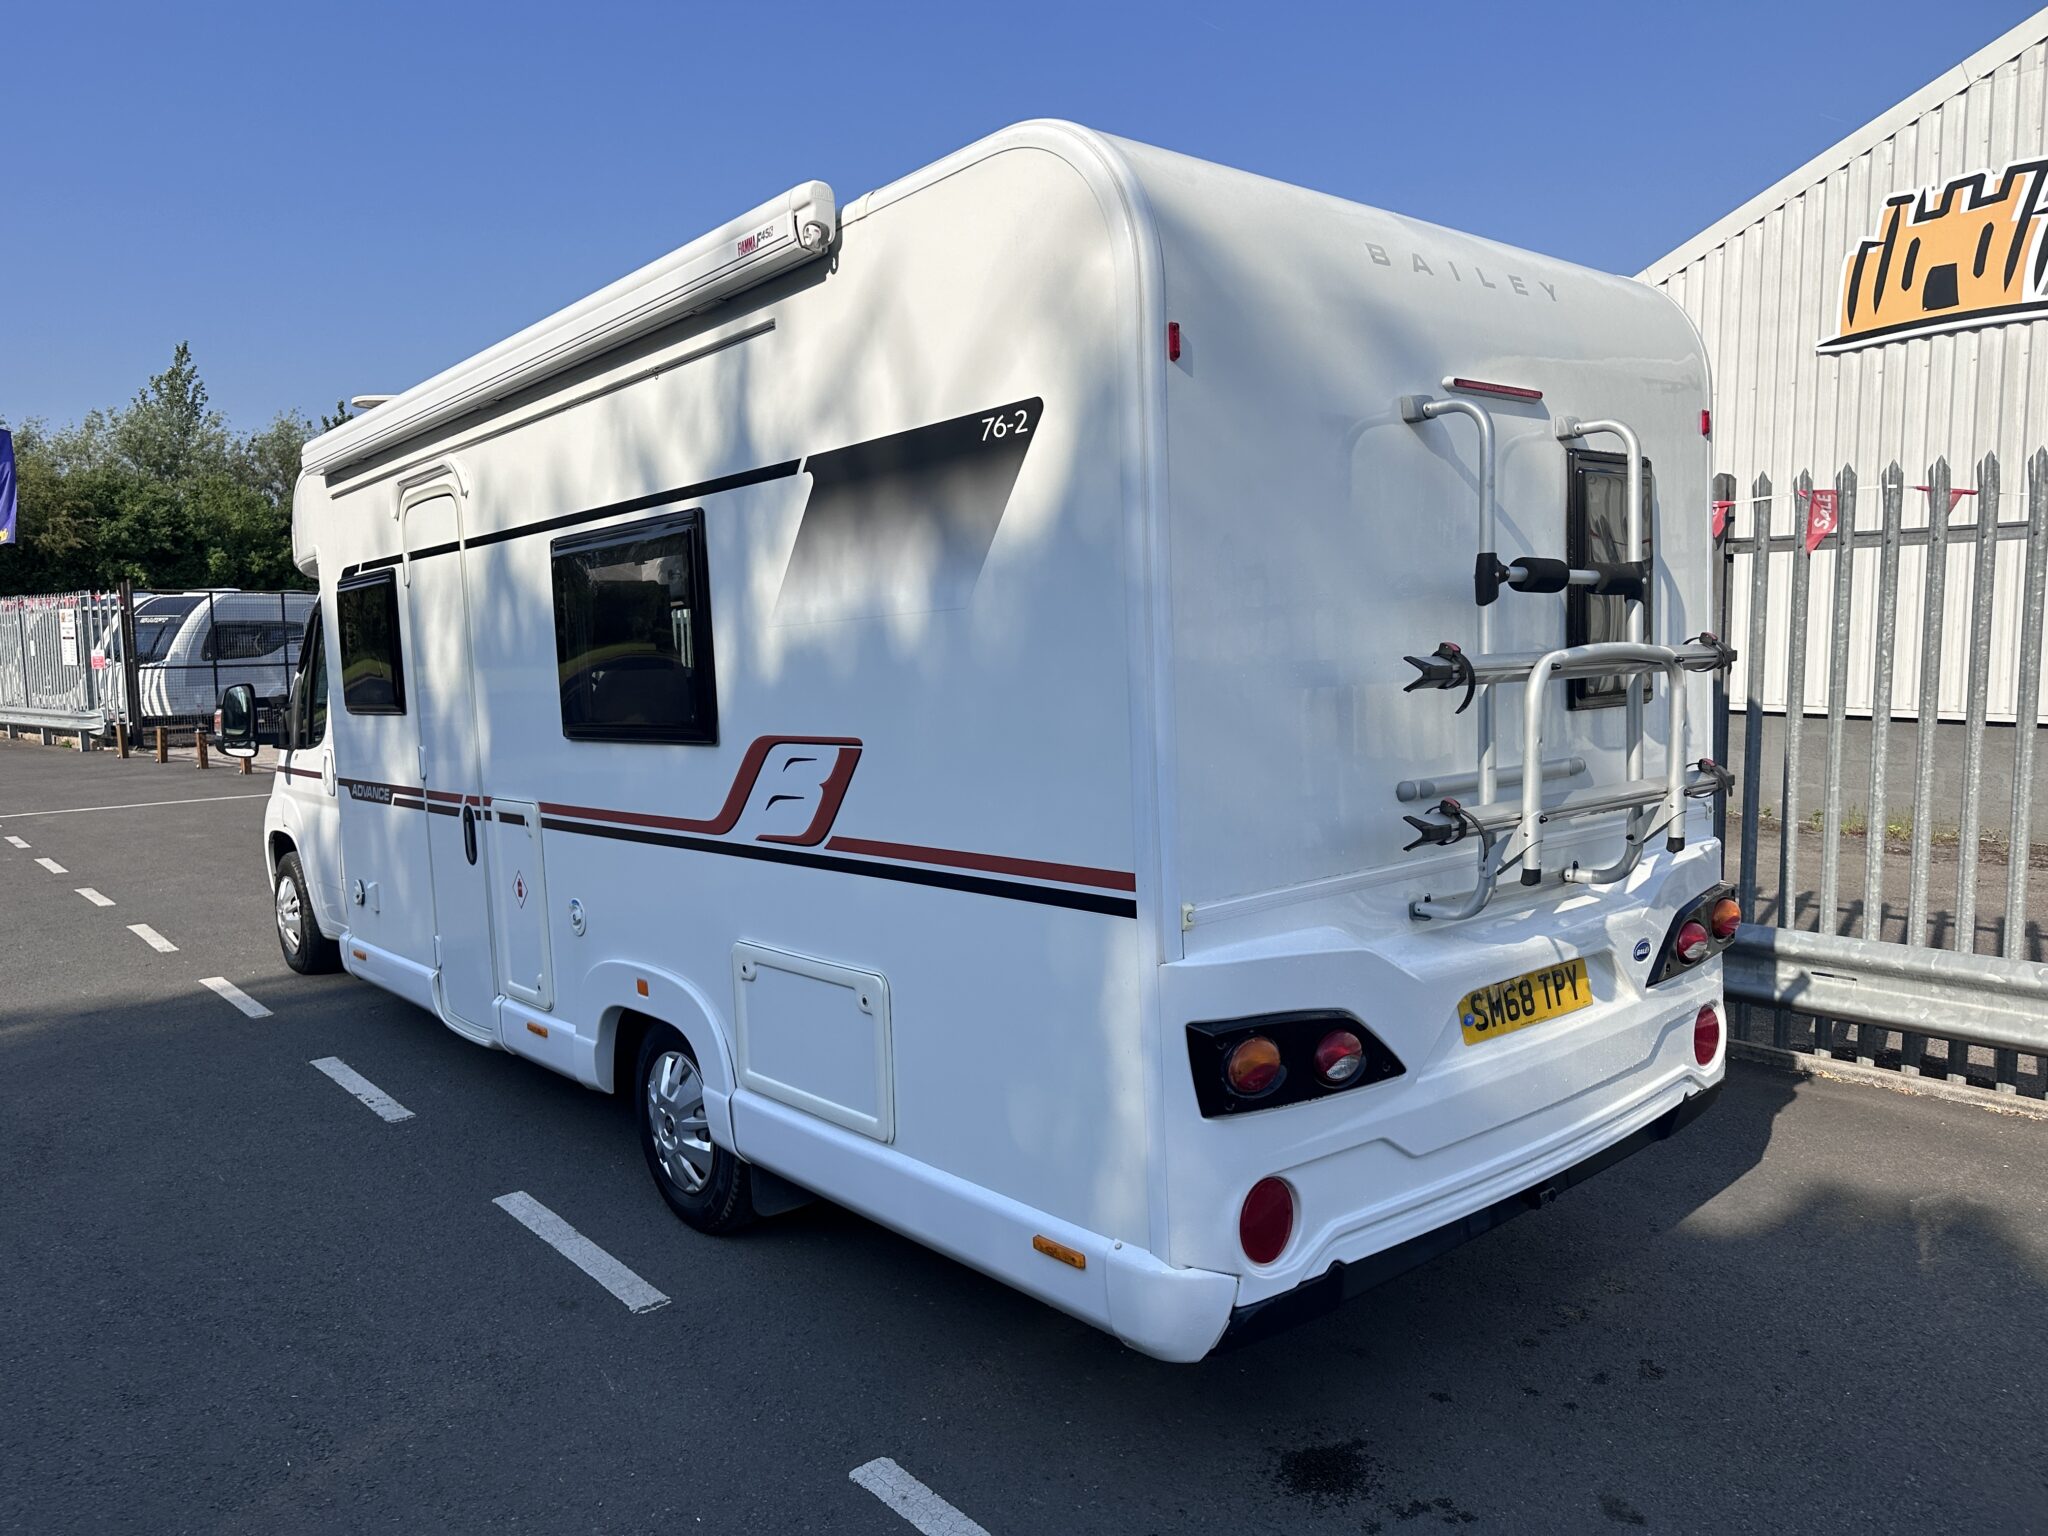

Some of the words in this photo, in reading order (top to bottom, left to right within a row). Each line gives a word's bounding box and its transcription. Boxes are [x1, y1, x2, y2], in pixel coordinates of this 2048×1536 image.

[1365, 242, 1557, 302] BAILEY
[981, 409, 1028, 441] 76-2
[1813, 494, 1832, 530] SALE
[351, 783, 390, 801] ADVANCE
[1470, 979, 1536, 1032] SM68
[1537, 964, 1579, 1010] TPY
